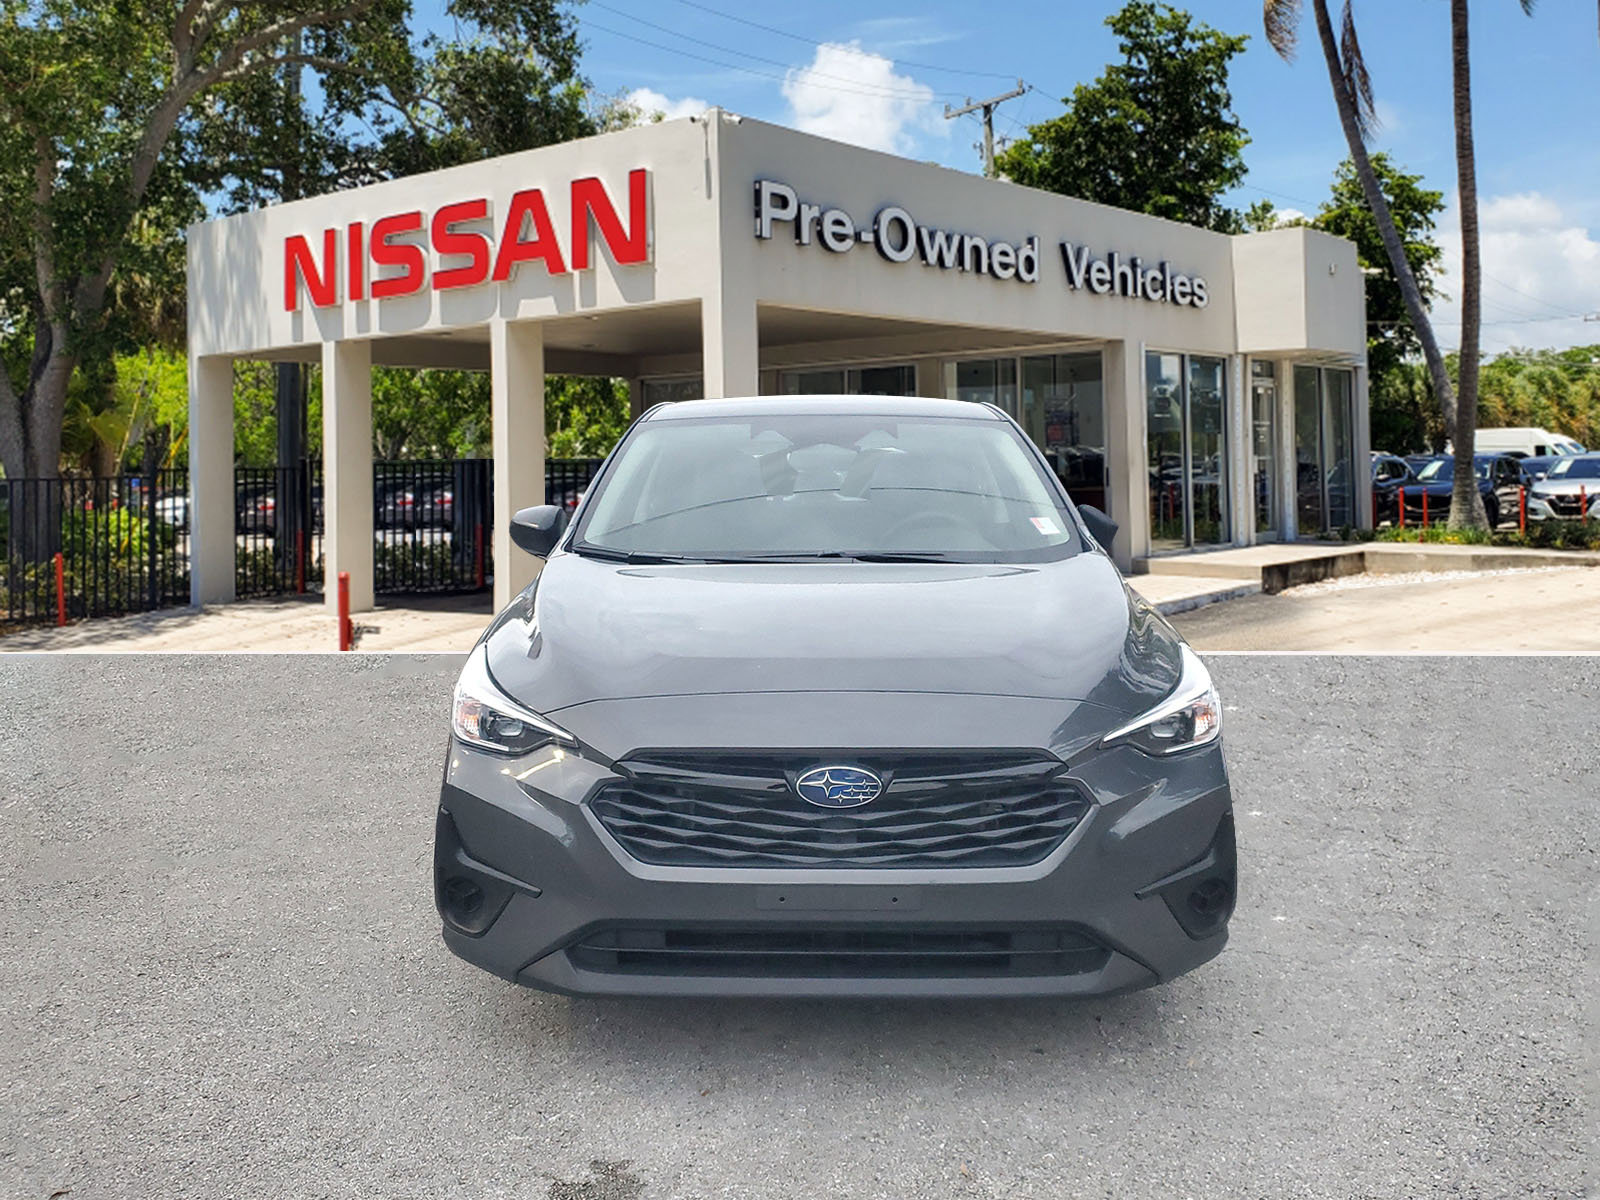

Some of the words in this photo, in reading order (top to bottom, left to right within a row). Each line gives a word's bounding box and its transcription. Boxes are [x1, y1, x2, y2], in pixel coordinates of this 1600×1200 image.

[285, 168, 648, 311] NISSAN
[755, 179, 1040, 283] Pre-Owned
[1061, 242, 1208, 308] Vehicles
